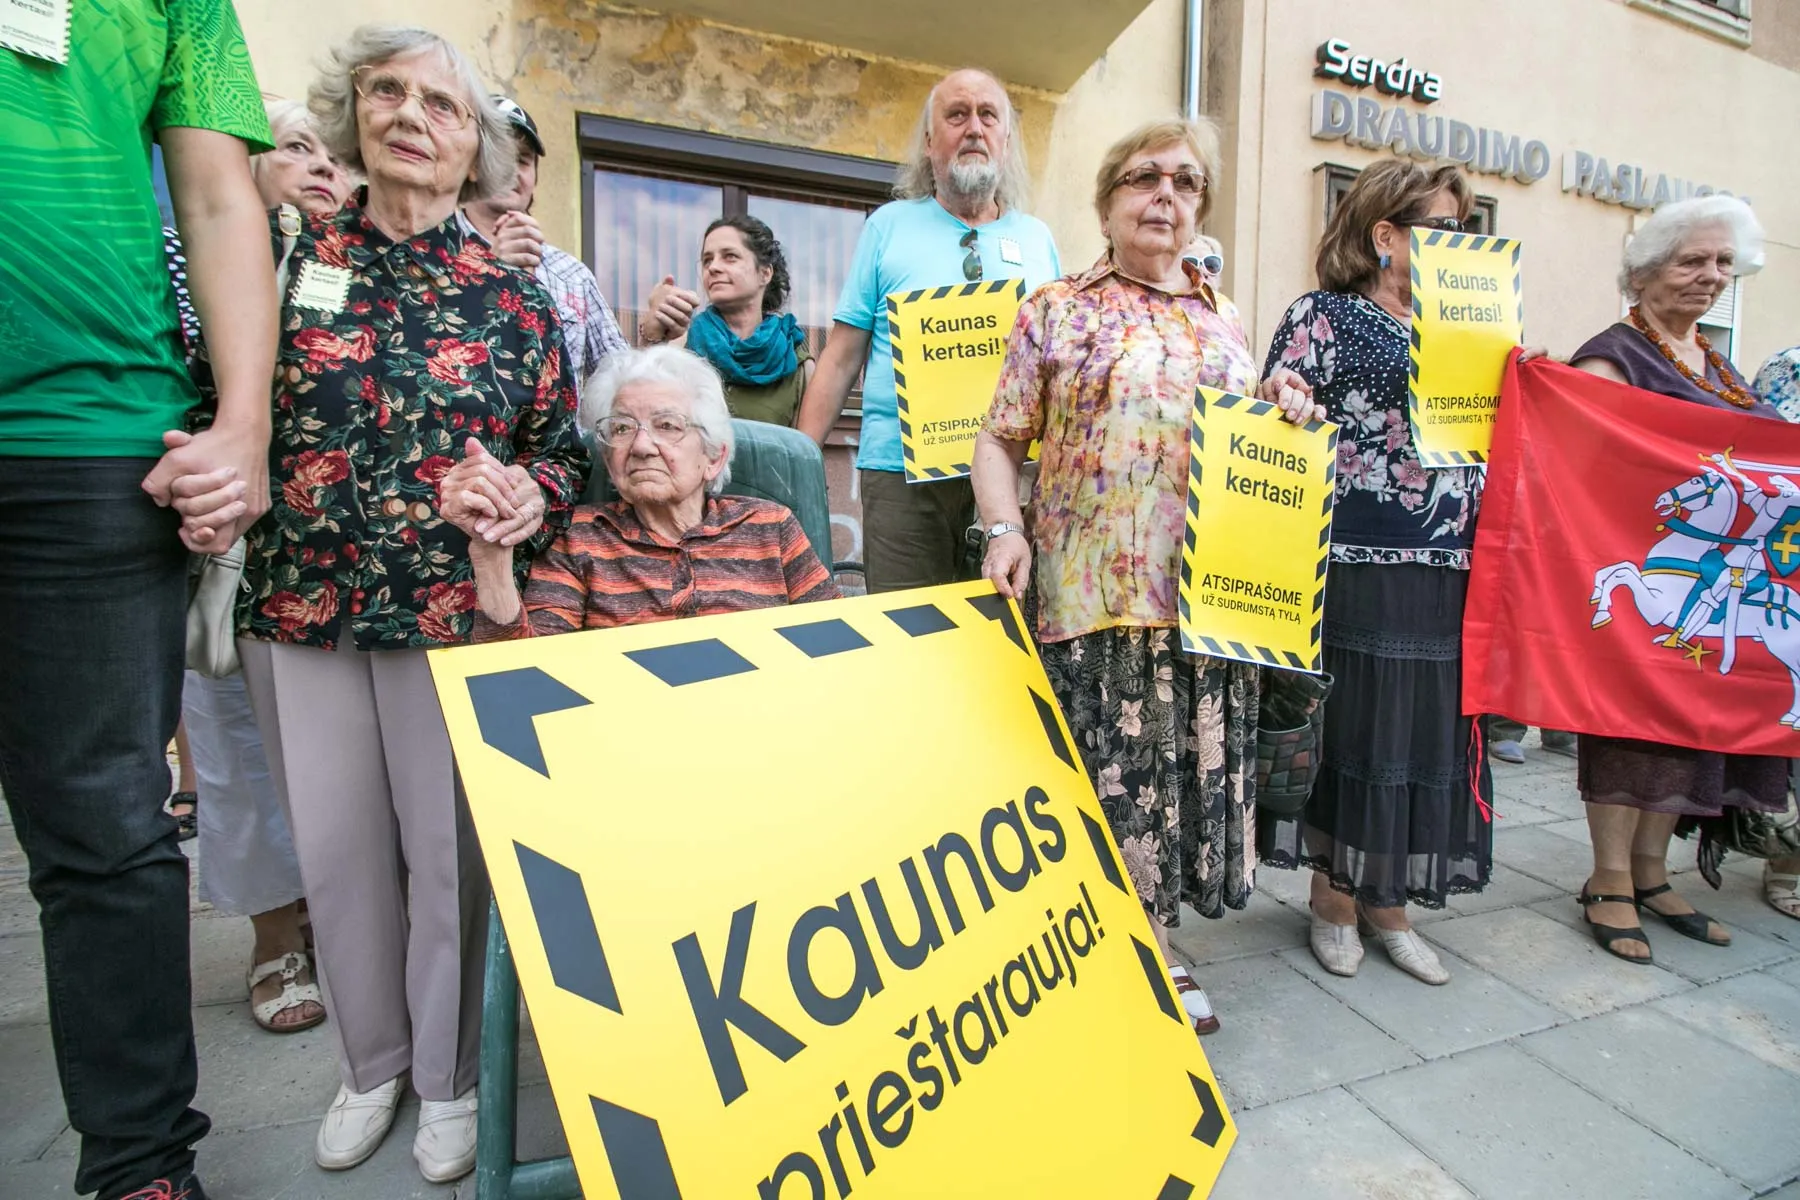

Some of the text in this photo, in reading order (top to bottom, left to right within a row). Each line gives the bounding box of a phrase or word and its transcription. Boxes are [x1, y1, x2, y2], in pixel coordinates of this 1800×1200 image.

[1317, 37, 1443, 102] Serdra
[1313, 89, 1550, 182] DRAUDIMO
[1437, 268, 1498, 292] Kaunas
[920, 314, 997, 335] Kaunas
[1439, 299, 1504, 323] kertasi!
[922, 338, 1001, 362] kertasi!
[1427, 413, 1438, 425] UŽ
[1438, 413, 1482, 425] SUDRUMSTĄ
[923, 435, 936, 446] UŽ
[1229, 432, 1308, 475] Kaunas
[1225, 466, 1304, 510] kertasi!
[1202, 573, 1303, 607] ATSIPRAŠOME
[1202, 593, 1302, 625] UŽ SUDRUMSTĄ TYLĄ
[671, 785, 1067, 1107] Kaunas
